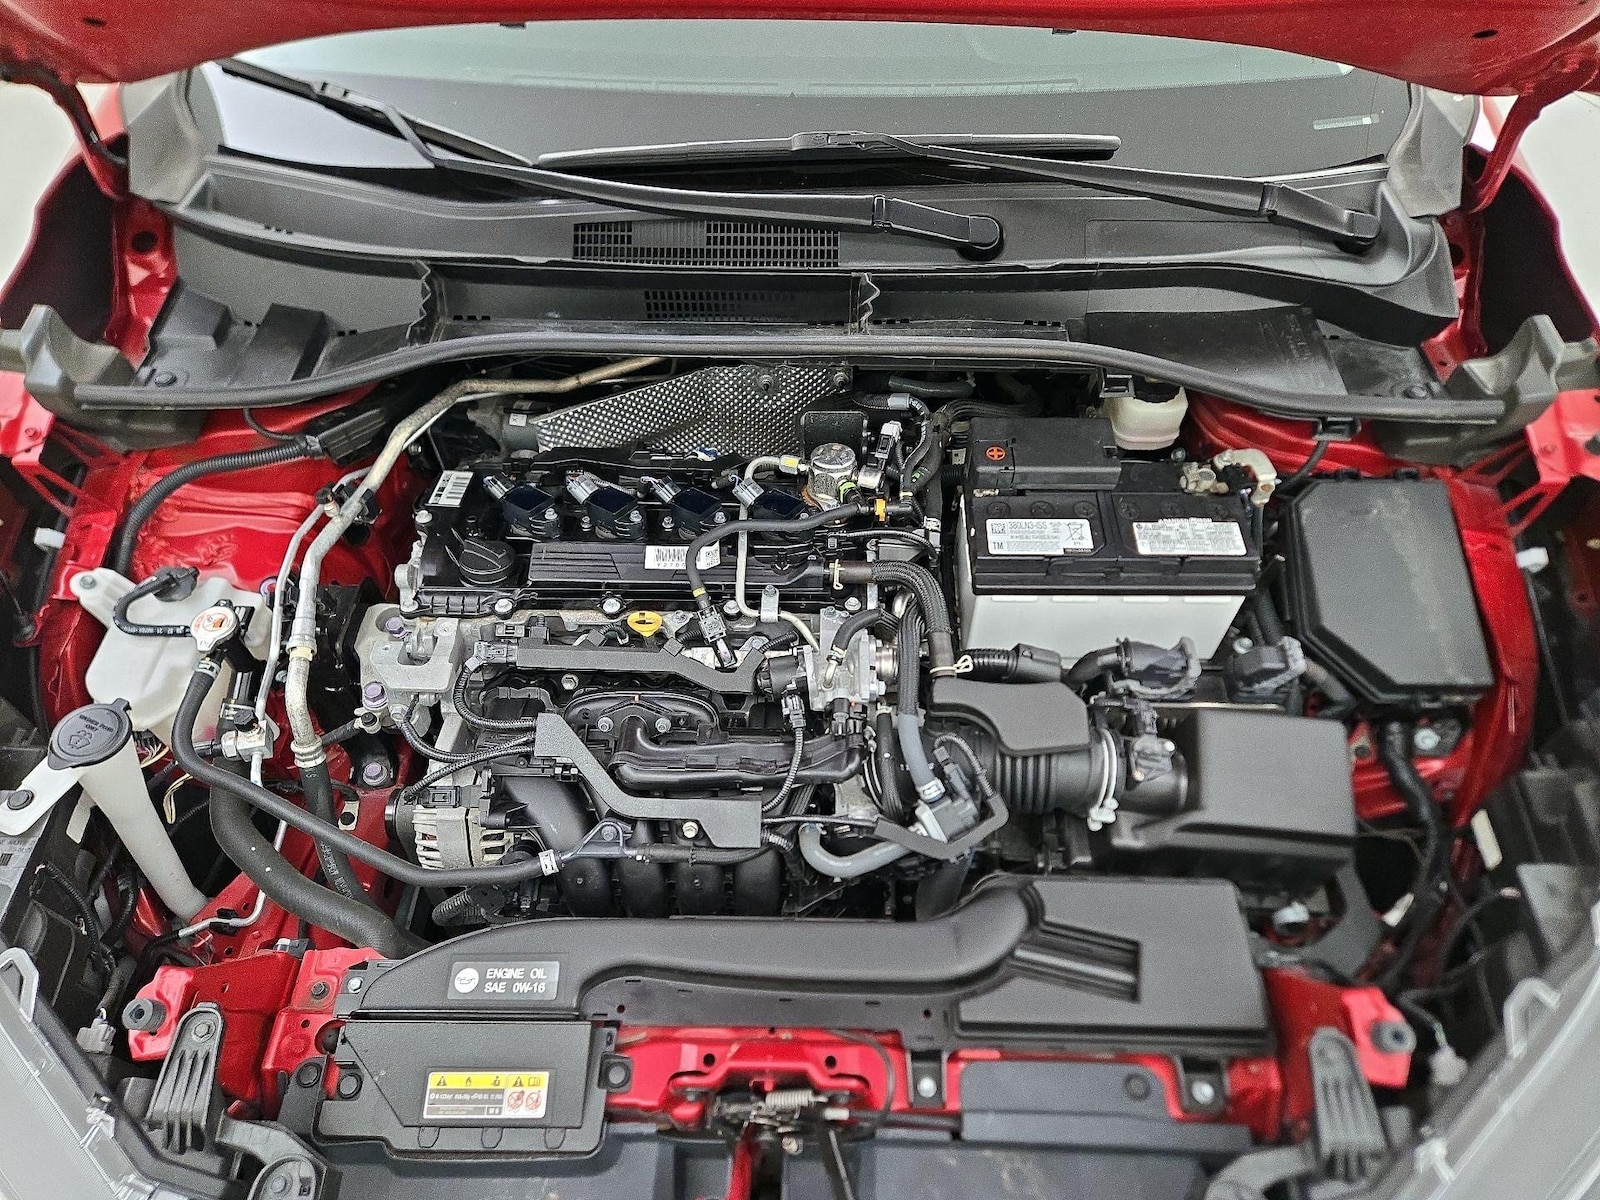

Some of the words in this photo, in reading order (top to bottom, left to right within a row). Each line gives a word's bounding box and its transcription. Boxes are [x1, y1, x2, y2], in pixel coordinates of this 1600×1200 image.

[486, 968, 525, 979] ENGINE
[529, 968, 548, 979] OIL
[483, 982, 507, 993] SAE
[512, 982, 546, 993] 0W-16
